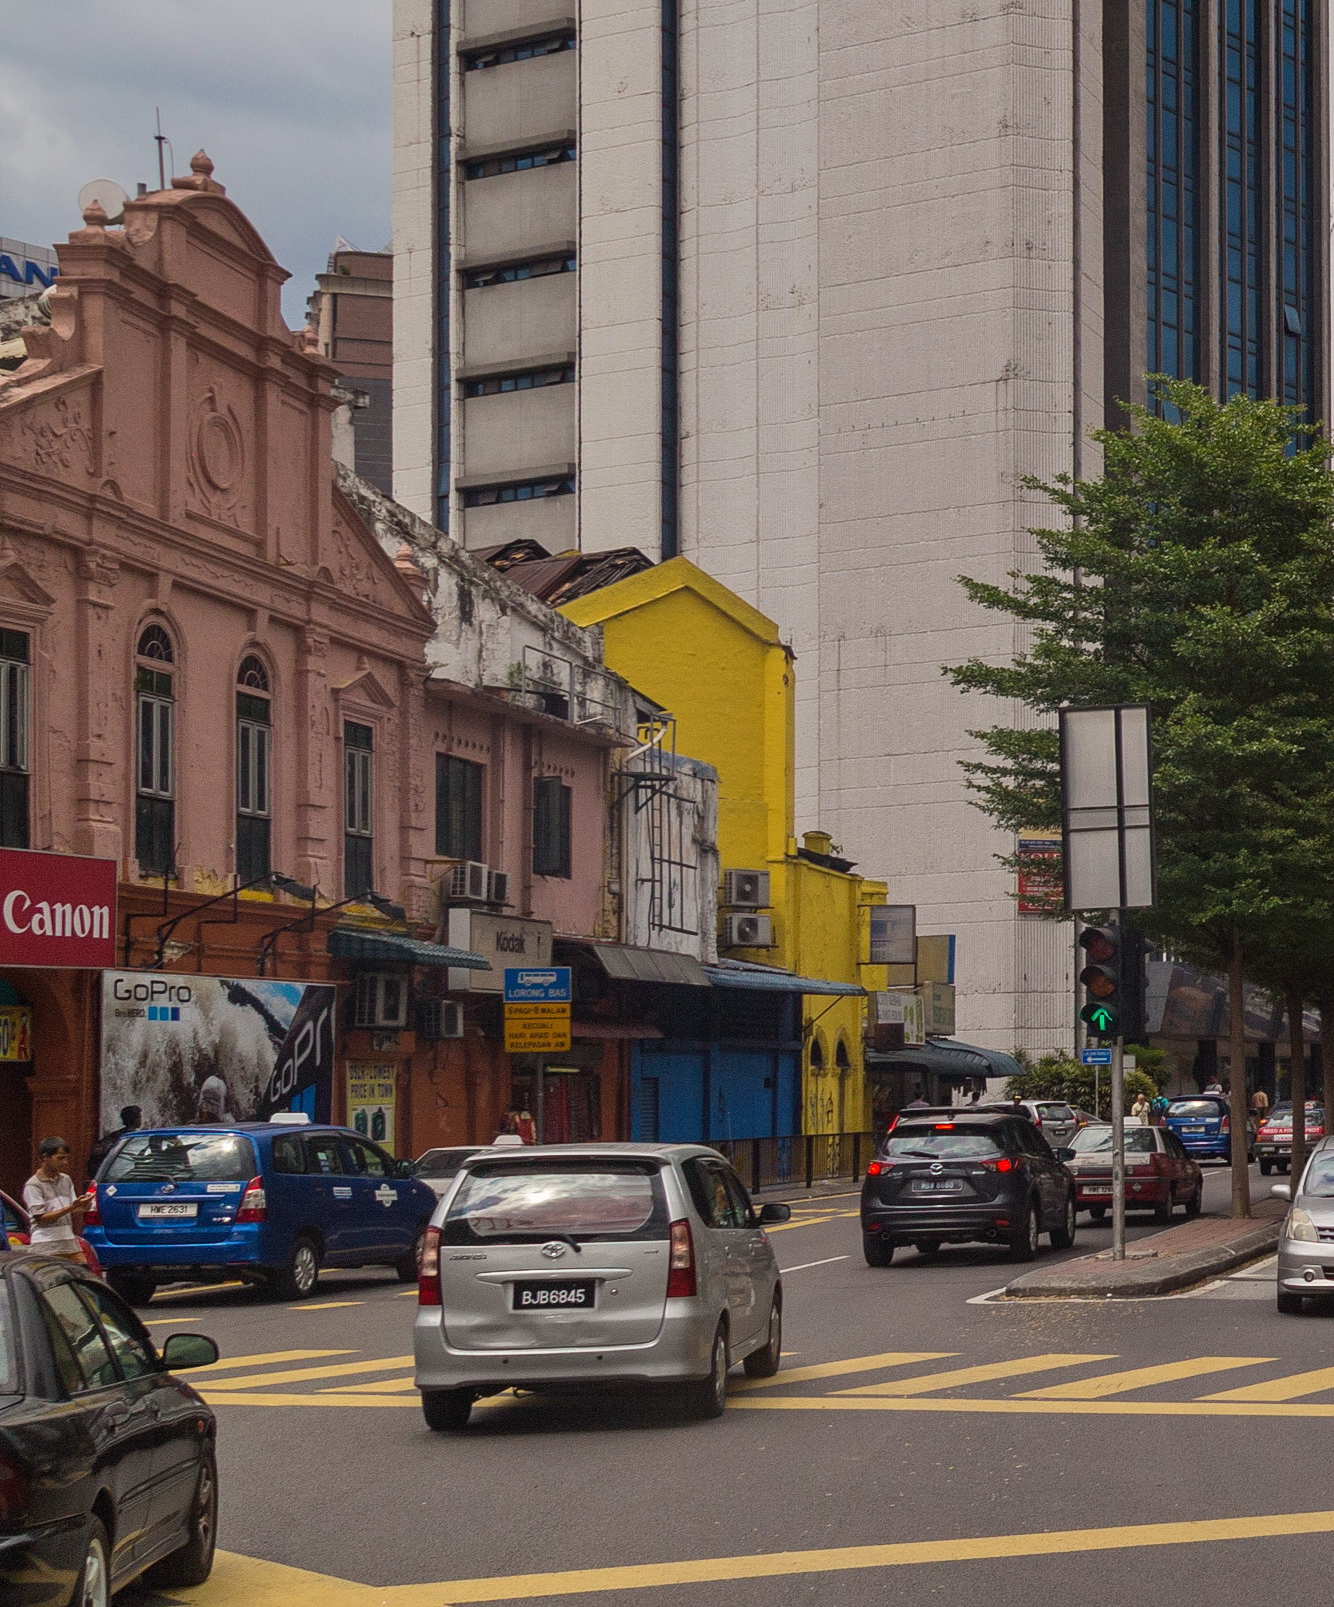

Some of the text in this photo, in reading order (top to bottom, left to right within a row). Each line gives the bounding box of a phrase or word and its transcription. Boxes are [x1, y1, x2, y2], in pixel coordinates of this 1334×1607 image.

[3, 889, 110, 939] Canon
[496, 931, 526, 954] Kodak
[114, 978, 192, 1003] GoPro
[508, 988, 566, 998] LORONG BAS
[150, 1205, 188, 1214] HWE 2631
[522, 1288, 586, 1305] BJB6845
